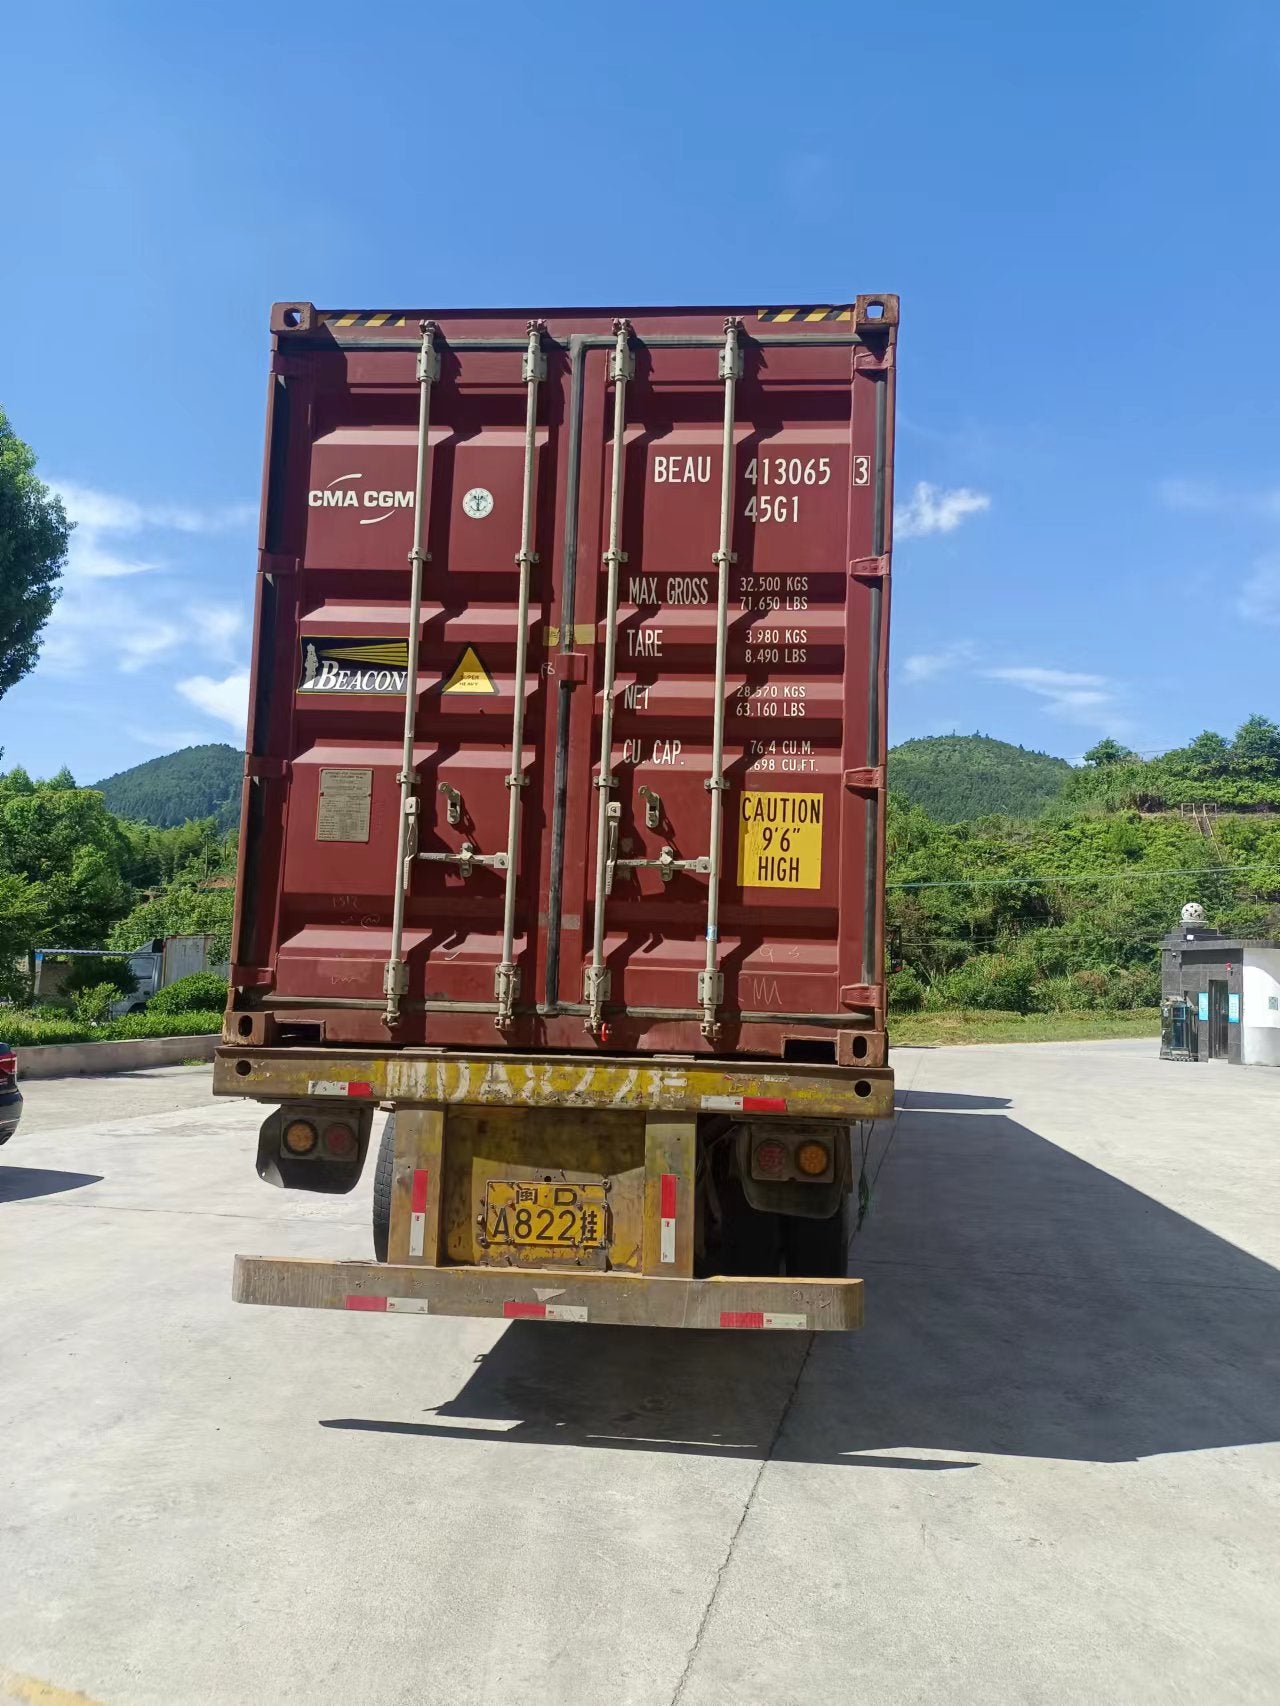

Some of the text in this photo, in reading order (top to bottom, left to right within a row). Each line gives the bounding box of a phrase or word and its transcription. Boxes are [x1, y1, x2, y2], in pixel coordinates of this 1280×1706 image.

[653, 456, 868, 485] BEAU 413065 3
[308, 490, 414, 508] CMA CGM
[743, 495, 799, 523] 45G1
[628, 577, 663, 605] MAX.
[666, 577, 708, 605] GROSS
[786, 576, 809, 592] KGS
[786, 596, 808, 611] LBS
[627, 629, 663, 657] TARE
[785, 629, 808, 644] KGS
[784, 649, 807, 664] LBS
[315, 660, 407, 691] BEACON
[624, 684, 650, 710] NET
[783, 685, 806, 698] KGS
[783, 701, 805, 717] LBS
[623, 738, 815, 766] CU. CAP. 76.4 CU.M.
[742, 797, 821, 824] CAUTION
[758, 857, 799, 883] HIGH
[492, 1207, 598, 1242] A822挂
